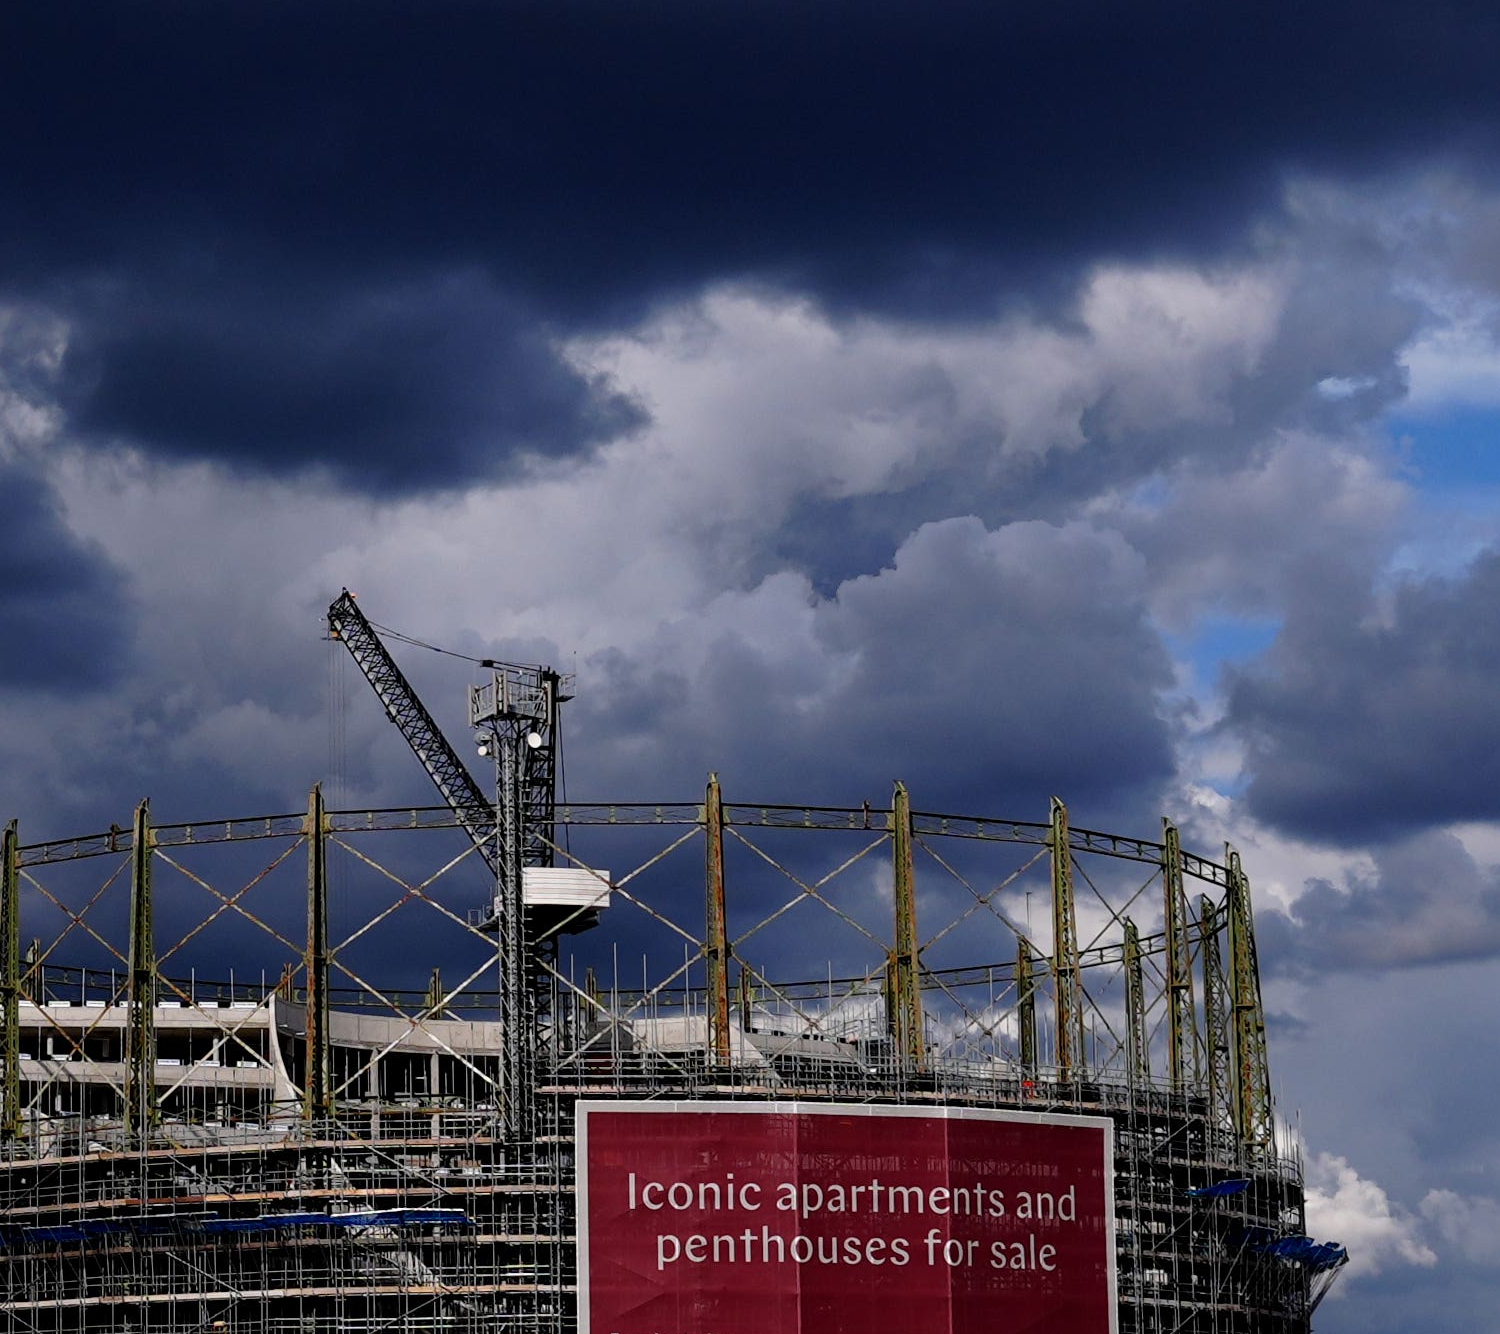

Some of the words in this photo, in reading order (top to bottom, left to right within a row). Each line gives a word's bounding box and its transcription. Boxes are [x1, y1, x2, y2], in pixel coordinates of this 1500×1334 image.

[627, 1173, 761, 1210] Iconic
[776, 1179, 1005, 1218] apartments
[1017, 1185, 1076, 1222] and
[657, 1226, 910, 1270] penthouses
[924, 1229, 979, 1267] for
[990, 1234, 1057, 1271] sale
